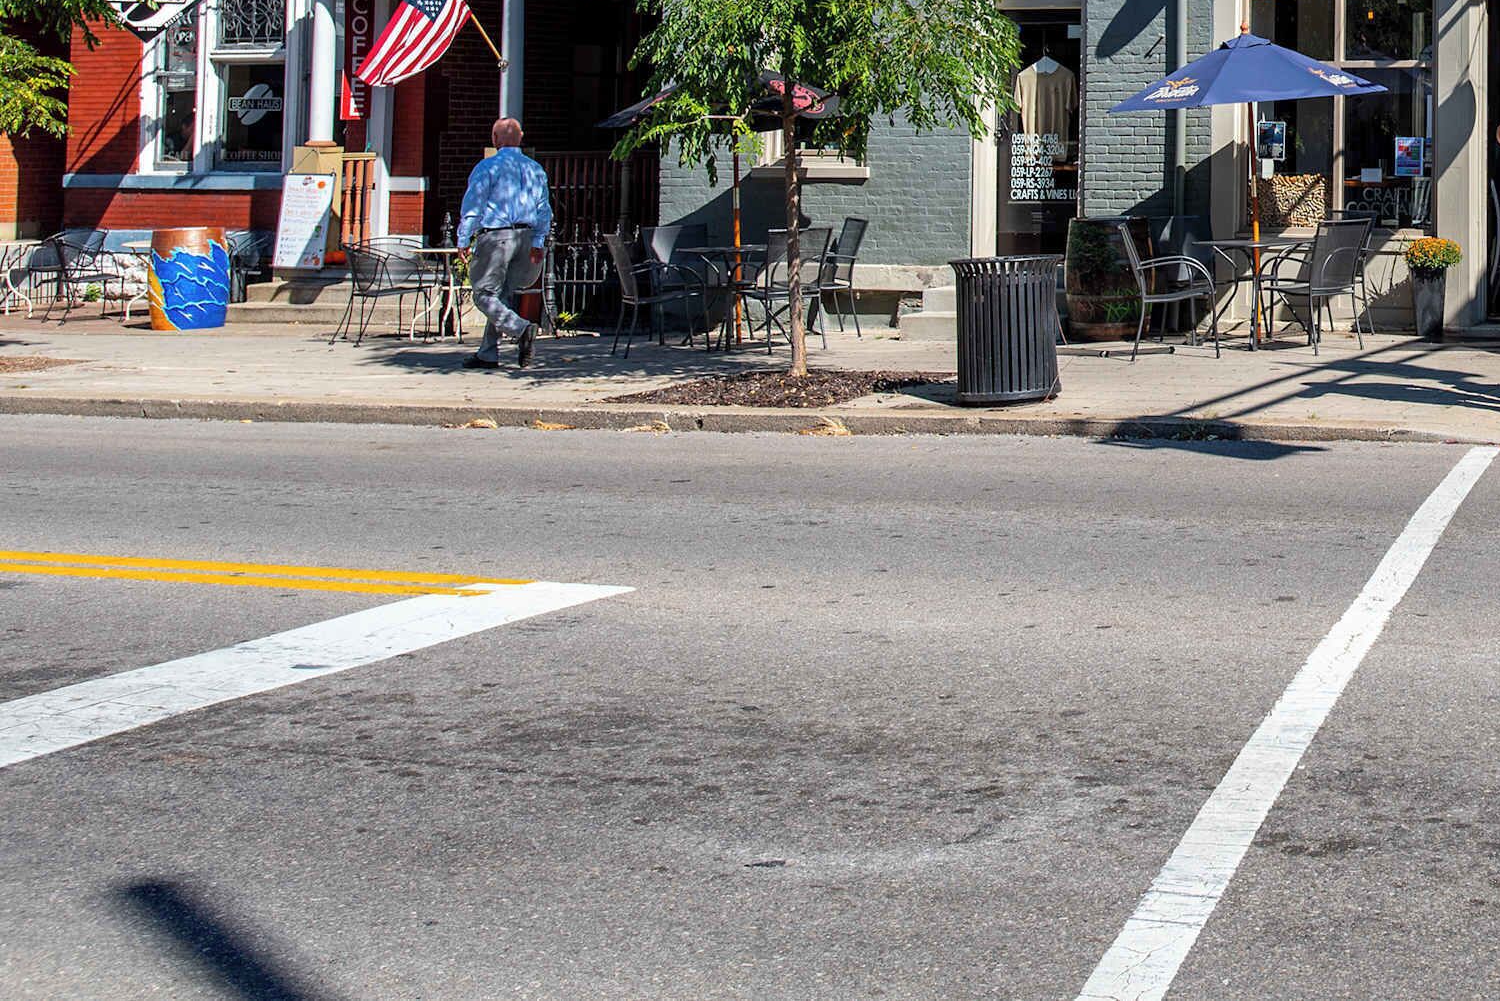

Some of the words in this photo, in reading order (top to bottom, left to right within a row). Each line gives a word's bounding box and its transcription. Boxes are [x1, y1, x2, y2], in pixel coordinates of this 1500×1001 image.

[231, 101, 254, 110] BEAN
[257, 100, 280, 110] HAUS
[1010, 166, 1053, 177] 059-LP-2267
[1010, 189, 1039, 199] CRAFTS
[1046, 189, 1067, 199] VINES
[1069, 189, 1077, 199] LL
[1362, 187, 1411, 201] CRAFT
